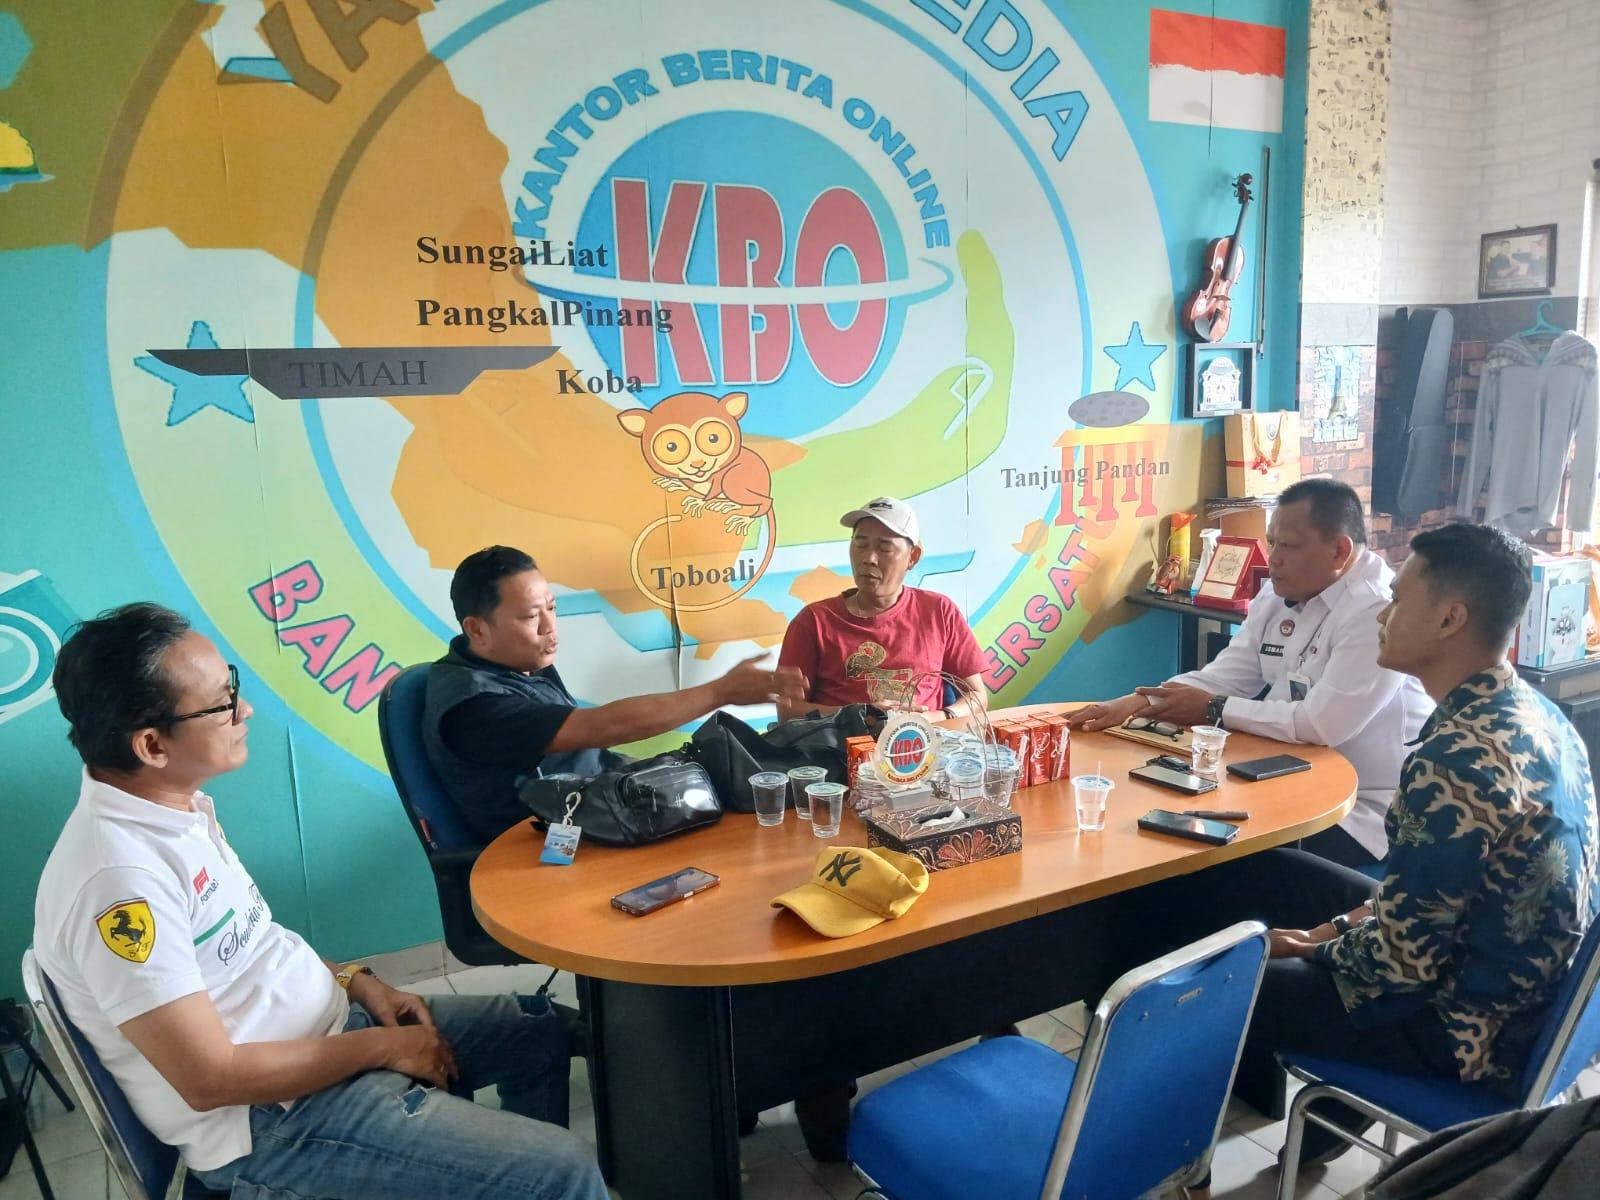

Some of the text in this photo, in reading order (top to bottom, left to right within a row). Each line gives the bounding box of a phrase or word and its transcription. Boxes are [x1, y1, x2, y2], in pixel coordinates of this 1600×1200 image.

[513, 49, 950, 249] KANTOR BERITA ONLINE
[416, 236, 608, 271] SungaiLiat
[612, 178, 888, 387] KBO
[415, 299, 673, 333] PangkalPinang
[288, 361, 428, 389] TIMAH
[556, 369, 642, 394] Koba
[1001, 456, 1170, 491] Tanjung Pandan
[650, 558, 756, 590] Toboali
